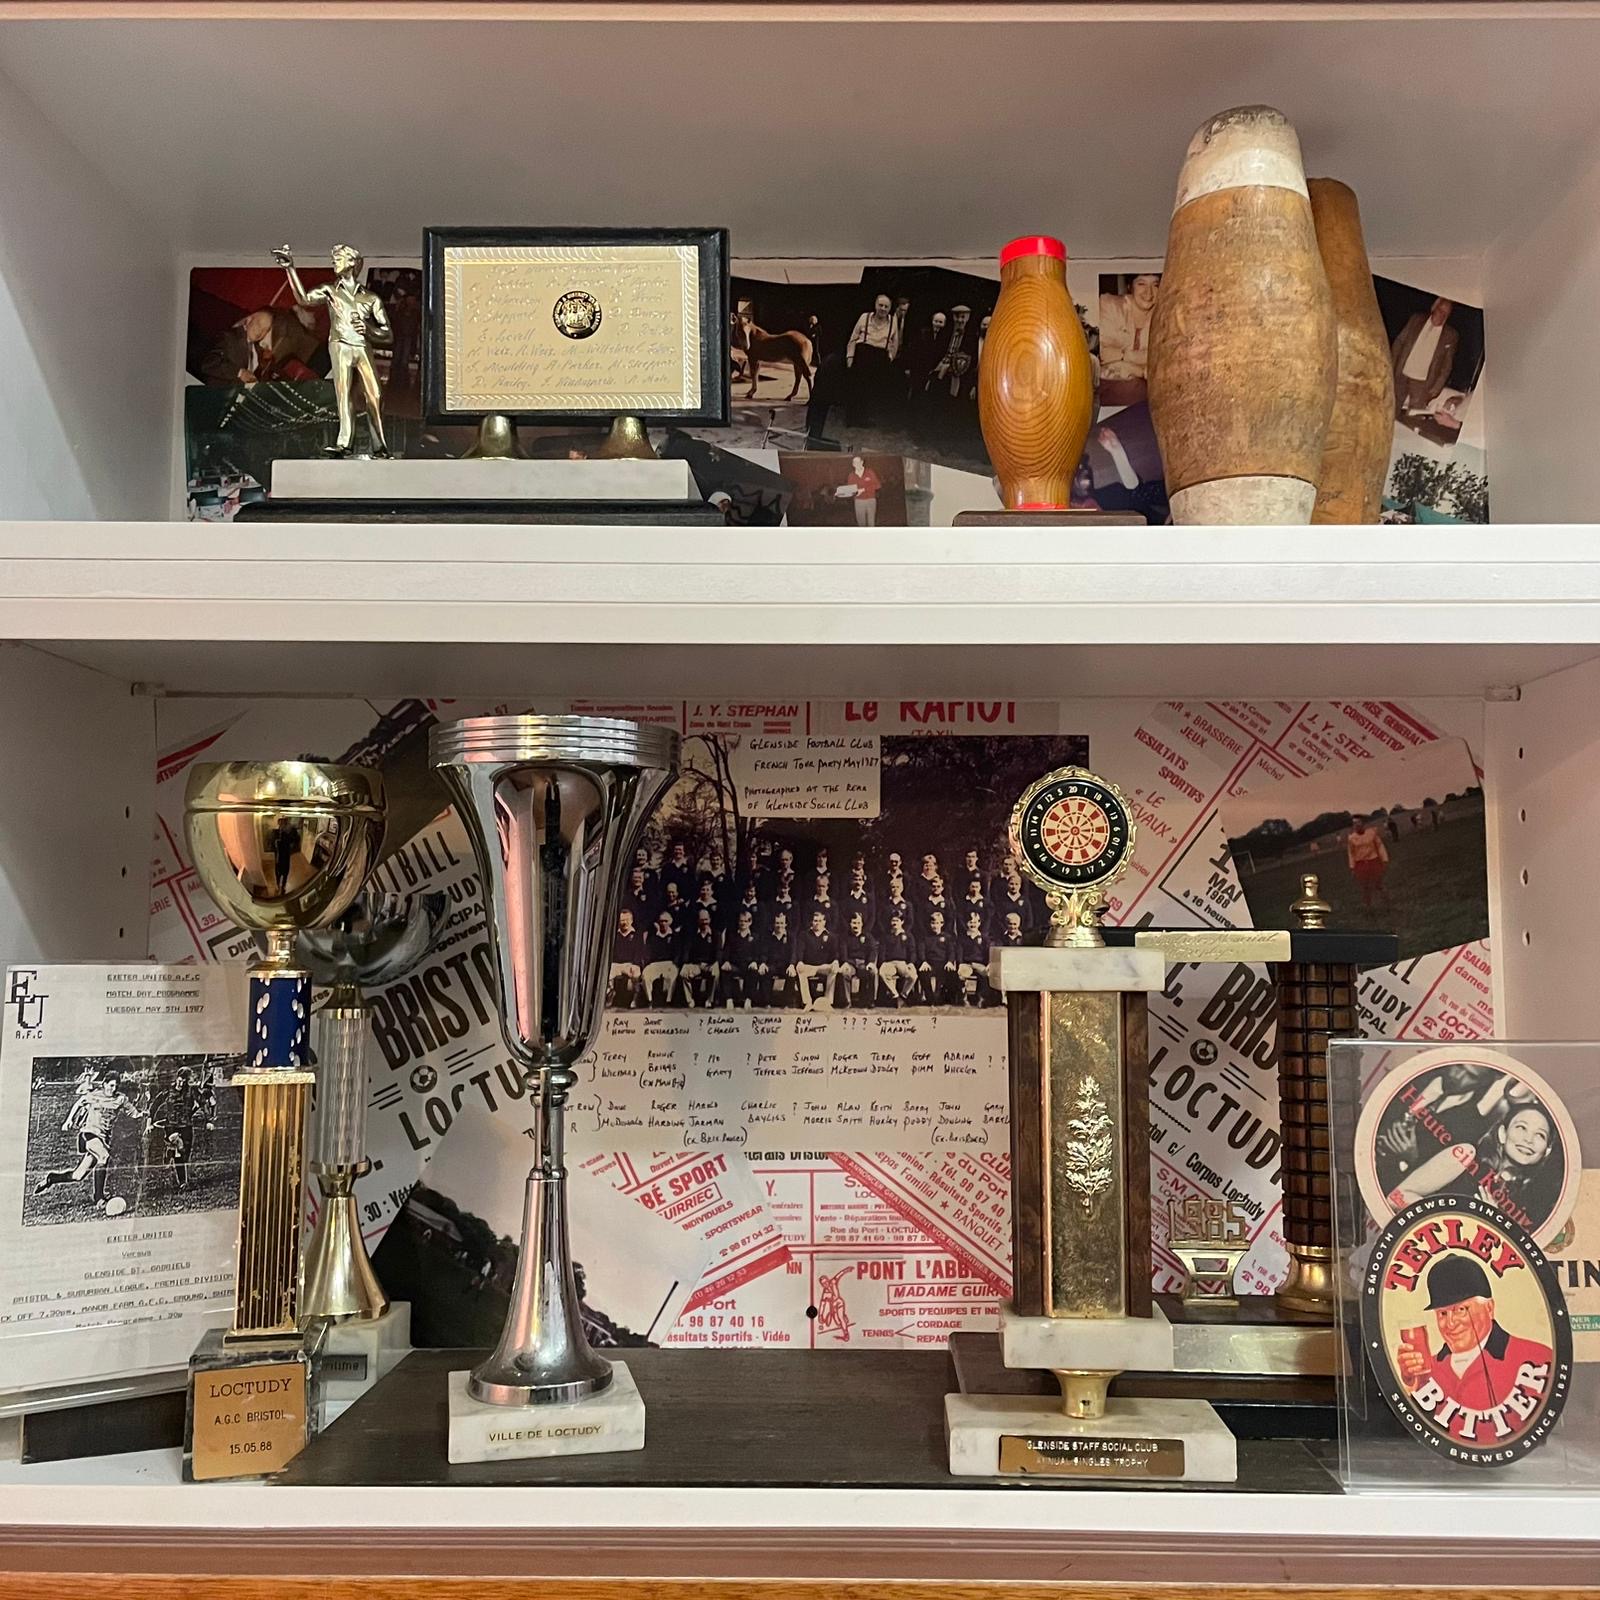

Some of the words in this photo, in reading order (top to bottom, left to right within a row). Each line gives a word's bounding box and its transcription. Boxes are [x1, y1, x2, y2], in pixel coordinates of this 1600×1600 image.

[693, 704, 703, 716] J.
[709, 704, 721, 716] Y.
[727, 704, 799, 717] STEPHAN
[1179, 726, 1208, 749] JEUX
[1193, 715, 1244, 756] BRASSERIE
[750, 739, 799, 750] GLENSIDE
[807, 737, 845, 749] FOOTBALL
[850, 739, 874, 749] CLUB
[1133, 726, 1189, 772] RESULTATS
[754, 760, 788, 771] FRENCH
[793, 759, 815, 769] TOUR
[817, 759, 842, 774] PARTY
[1257, 758, 1285, 782] Michel
[1068, 786, 1078, 794] 20
[1158, 765, 1206, 804] SPORTIFS
[744, 785, 800, 799] PHOTOGRAPHED
[1045, 794, 1055, 803] 12
[1093, 792, 1102, 801] 18
[747, 802, 758, 810] OF
[765, 800, 807, 810] GLENSIDE
[809, 800, 842, 810] SOCIAL
[843, 800, 869, 810] CLUB
[1031, 815, 1039, 824] 14
[1061, 867, 1070, 875] 19
[1086, 866, 1095, 875] 17
[1208, 872, 1243, 903] MAI
[1205, 886, 1231, 909] 1988
[1455, 965, 1490, 995] dames
[106, 990, 132, 998] MATCH
[136, 990, 152, 998] DAY
[155, 990, 200, 998] PROGRAMME
[185, 1005, 204, 1013] 1987
[366, 942, 498, 1071] BRISTO
[613, 1017, 629, 1027] RAY
[795, 1017, 812, 1026] ROY
[875, 1017, 912, 1026] STUART
[15, 1030, 43, 1039] A.F.C
[644, 1027, 690, 1036] RICHARDSON
[880, 1026, 917, 1035] HARDING
[602, 1054, 627, 1063] TERRY
[794, 1052, 820, 1061] SIMON
[832, 1053, 858, 1061] ROGER
[871, 1053, 896, 1062] TERRY
[943, 1052, 976, 1061] ADRIAN
[576, 1103, 596, 1112] ROW
[651, 1100, 677, 1110] ROGER
[740, 1101, 778, 1110] CHARLIE
[803, 1101, 827, 1111] JOHN
[836, 1102, 861, 1110] ALAN
[870, 1101, 892, 1111] KEITH
[938, 1101, 961, 1111] JOHN
[984, 1102, 1005, 1112] GARY
[648, 1117, 685, 1127] HARDING
[688, 1115, 725, 1127] JARMAN
[803, 1116, 832, 1124] MORRIS
[836, 1115, 863, 1124] SMITH
[1399, 1084, 1454, 1145] Heute
[1452, 1145, 1480, 1176] ein
[669, 1154, 729, 1196] SPORT
[958, 1159, 977, 1176] du
[978, 1172, 1009, 1200] Port
[941, 1161, 957, 1181] Tél.
[991, 1203, 1005, 1218] 40
[1185, 1152, 1223, 1189] Corpos
[1222, 1179, 1266, 1221] Loctudy
[664, 1188, 714, 1221] UIRRIEC
[900, 1167, 938, 1200] Familial
[953, 1208, 1006, 1251] BANQUET
[929, 1171, 968, 1206] Résultats
[968, 1202, 1002, 1234] Sportifs
[682, 1200, 734, 1231] INDIVIDUELS
[704, 1205, 764, 1240] SPORTSWEAR
[831, 1226, 845, 1234] Rue
[849, 1226, 859, 1234] du
[106, 1235, 138, 1244] EXETER
[142, 1231, 173, 1240] UNITED
[1367, 1231, 1395, 1295] SMOOTH
[1397, 1198, 1457, 1226] BREWED
[1469, 1201, 1514, 1230] SINCE
[1518, 1235, 1545, 1268] 1822
[1383, 1219, 1527, 1293] TETLEY
[84, 1269, 126, 1280] GLENSIDE
[150, 1262, 191, 1273] GABRIELS
[857, 1261, 906, 1280] PONT
[13, 1293, 51, 1304] BRISTOL
[67, 1287, 110, 1298] SUBURBAN
[154, 1279, 192, 1288] PREMIER
[894, 1285, 957, 1298] MADAME
[17, 1313, 34, 1321] OFF
[81, 1304, 110, 1313] MANOR
[113, 1301, 135, 1311] FARM
[879, 1308, 916, 1317] SPORTS
[971, 1307, 982, 1315] ET
[689, 1316, 704, 1327] 98
[710, 1316, 724, 1327] 87
[730, 1316, 745, 1327] 40
[751, 1316, 764, 1327] 16
[917, 1320, 963, 1329] CORDAGE
[711, 1331, 753, 1344] Sportifs
[762, 1331, 791, 1342] Vidéo
[862, 1329, 895, 1337] TENNIS
[209, 1378, 292, 1398] LOCTUDY
[1409, 1360, 1552, 1441] BITTER
[247, 1410, 287, 1423] BRISTOL
[1391, 1393, 1442, 1447] SMOOTH
[1449, 1448, 1515, 1463] BREWED
[1522, 1408, 1557, 1449] SINCE
[1555, 1363, 1569, 1399] 1822
[489, 1431, 523, 1442] VILLE
[527, 1430, 543, 1439] DE
[547, 1425, 602, 1438] LOCTUDY
[229, 1441, 273, 1455] 15.05.88
[1026, 1440, 1070, 1450] GLENSIDE
[1072, 1441, 1100, 1450] STAFF
[1102, 1441, 1132, 1451] SOCIAL
[1134, 1442, 1159, 1452] CLUB
[1073, 1457, 1111, 1467] SINGLES
[1113, 1458, 1149, 1467] TROPHY
